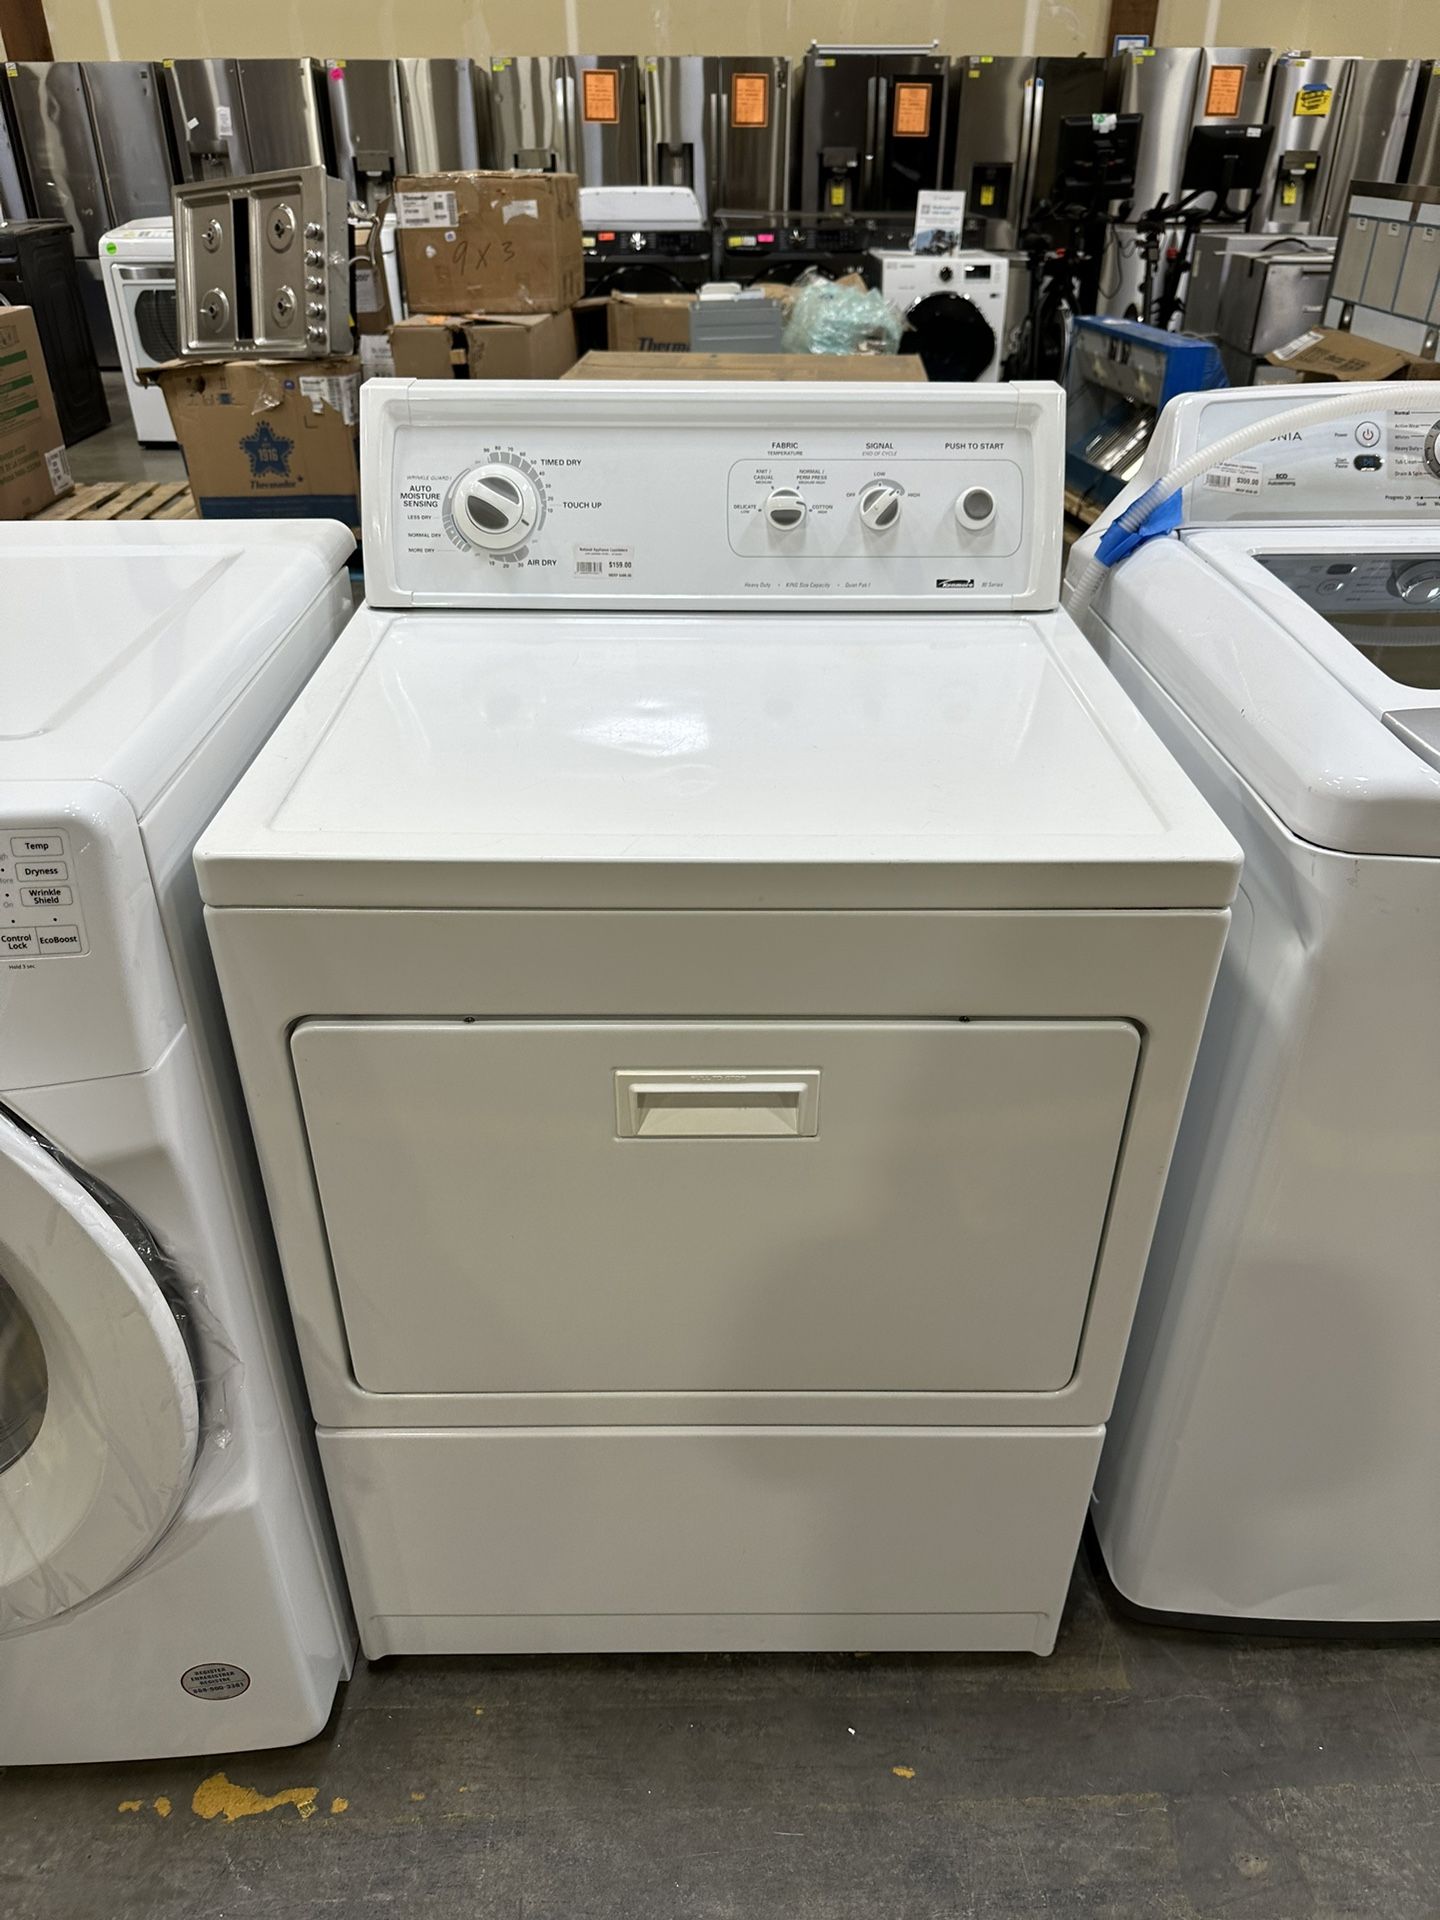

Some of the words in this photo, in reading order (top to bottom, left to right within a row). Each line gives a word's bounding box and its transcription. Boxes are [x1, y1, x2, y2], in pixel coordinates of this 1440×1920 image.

[453, 241, 468, 276] 9
[502, 241, 516, 262] 3
[403, 500, 438, 508] SENSING
[25, 842, 49, 851] Temp
[25, 868, 58, 876] Dryness
[34, 896, 59, 904] Shield
[1, 934, 32, 942] Control
[40, 935, 77, 944] EcoBoost
